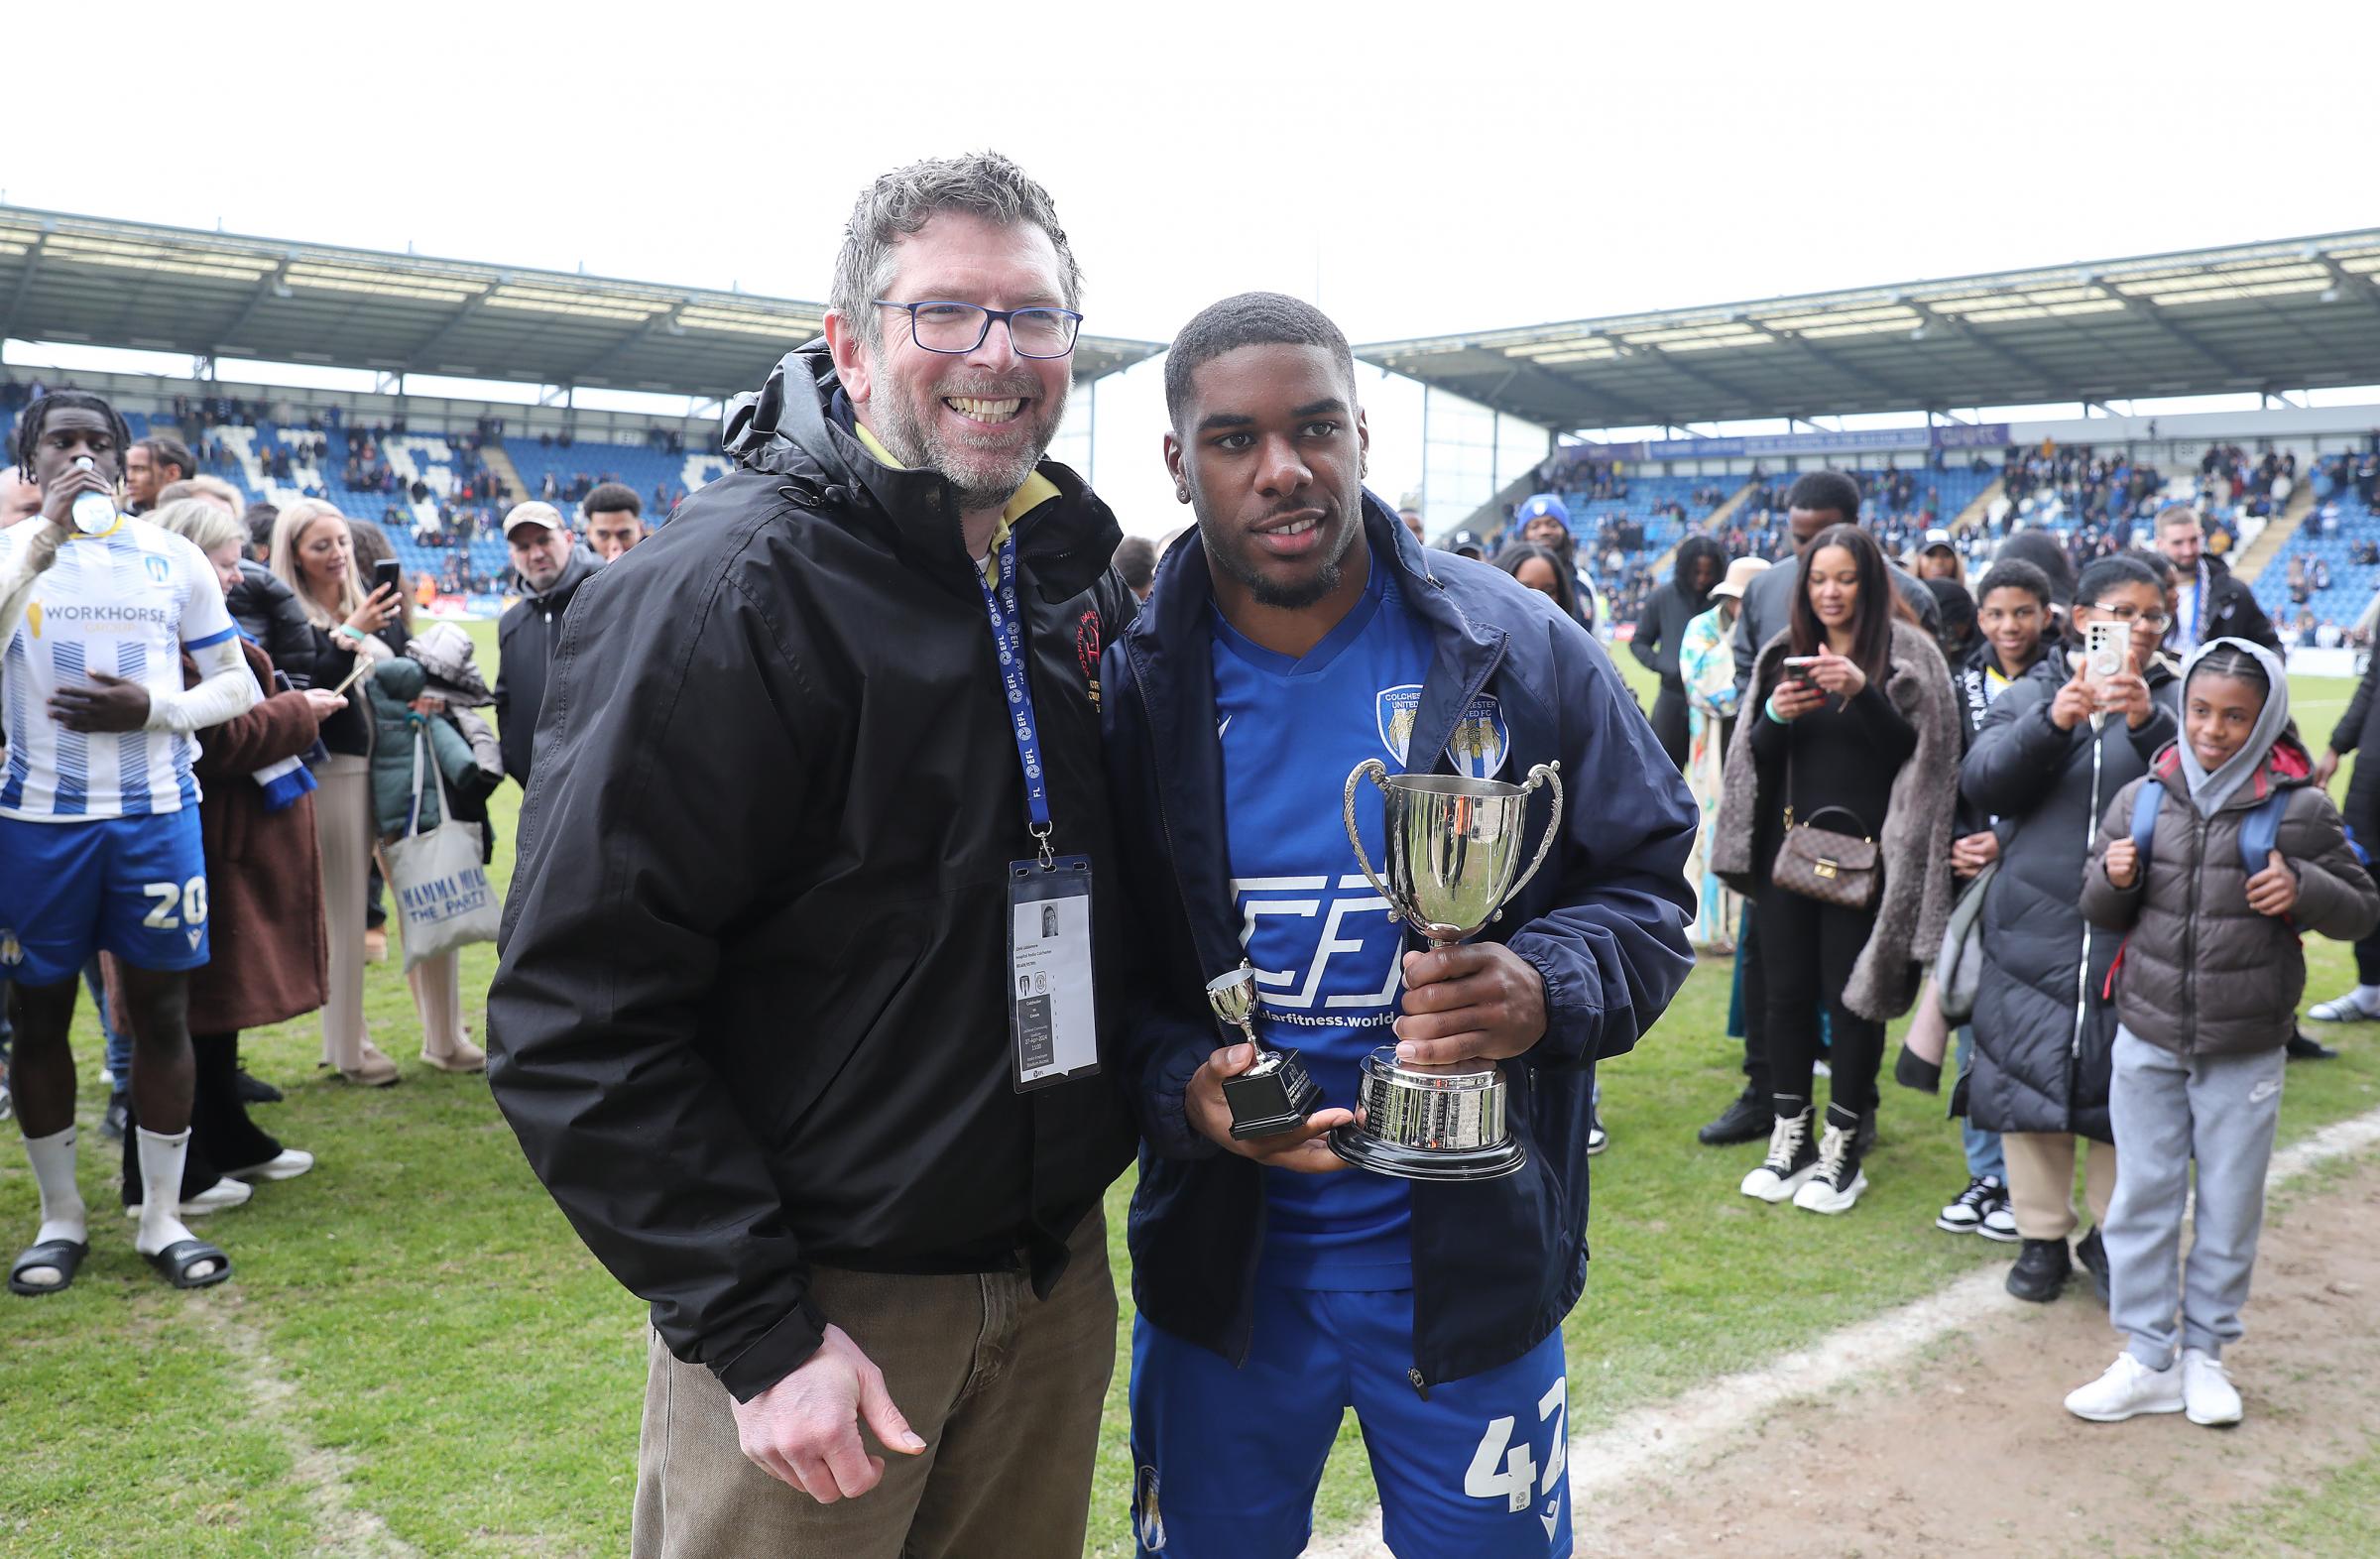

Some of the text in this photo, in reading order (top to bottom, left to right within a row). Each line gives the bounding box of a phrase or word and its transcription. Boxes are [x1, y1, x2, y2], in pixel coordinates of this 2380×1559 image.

[1003, 565, 1012, 580] EFL
[988, 597, 997, 613] EFL
[1006, 599, 1015, 615] EFL
[46, 606, 167, 624] WORKHORSE
[998, 635, 1008, 651] EFL
[1010, 635, 1020, 651] EFL
[1006, 672, 1017, 689] EFL
[1391, 700, 1419, 709] UNITED
[1470, 700, 1496, 710] ESTER
[1016, 710, 1026, 727] EFL
[1024, 748, 1035, 765] EFL
[402, 876, 457, 908] MAMMA
[143, 876, 208, 929] 20
[411, 906, 437, 922] THE
[1464, 1376, 1567, 1513] 42
